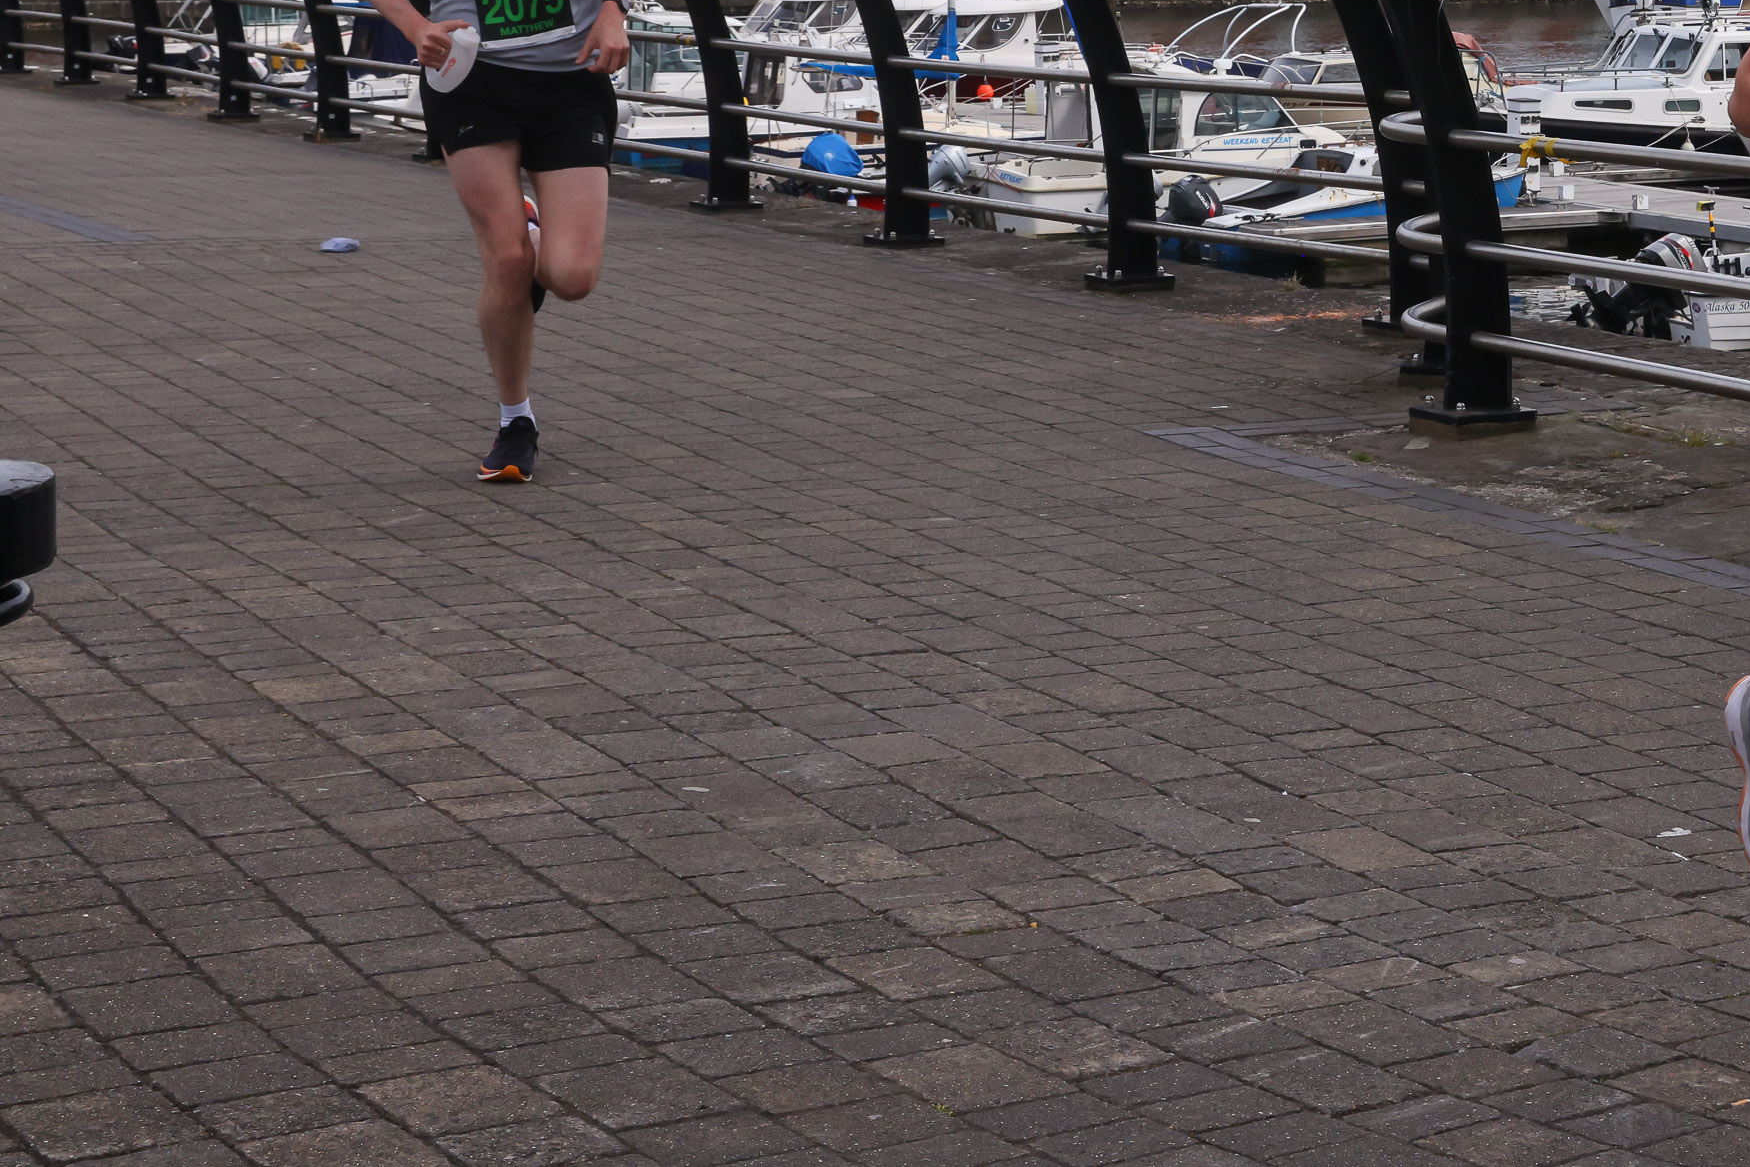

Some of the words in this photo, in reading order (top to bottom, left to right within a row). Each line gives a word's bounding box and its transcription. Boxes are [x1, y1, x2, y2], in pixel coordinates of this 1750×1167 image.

[500, 18, 554, 36] MATTHEW
[1223, 137, 1259, 145] WEEKEND
[1195, 190, 1210, 210] SUZUKI
[1704, 300, 1735, 313] Alaska
